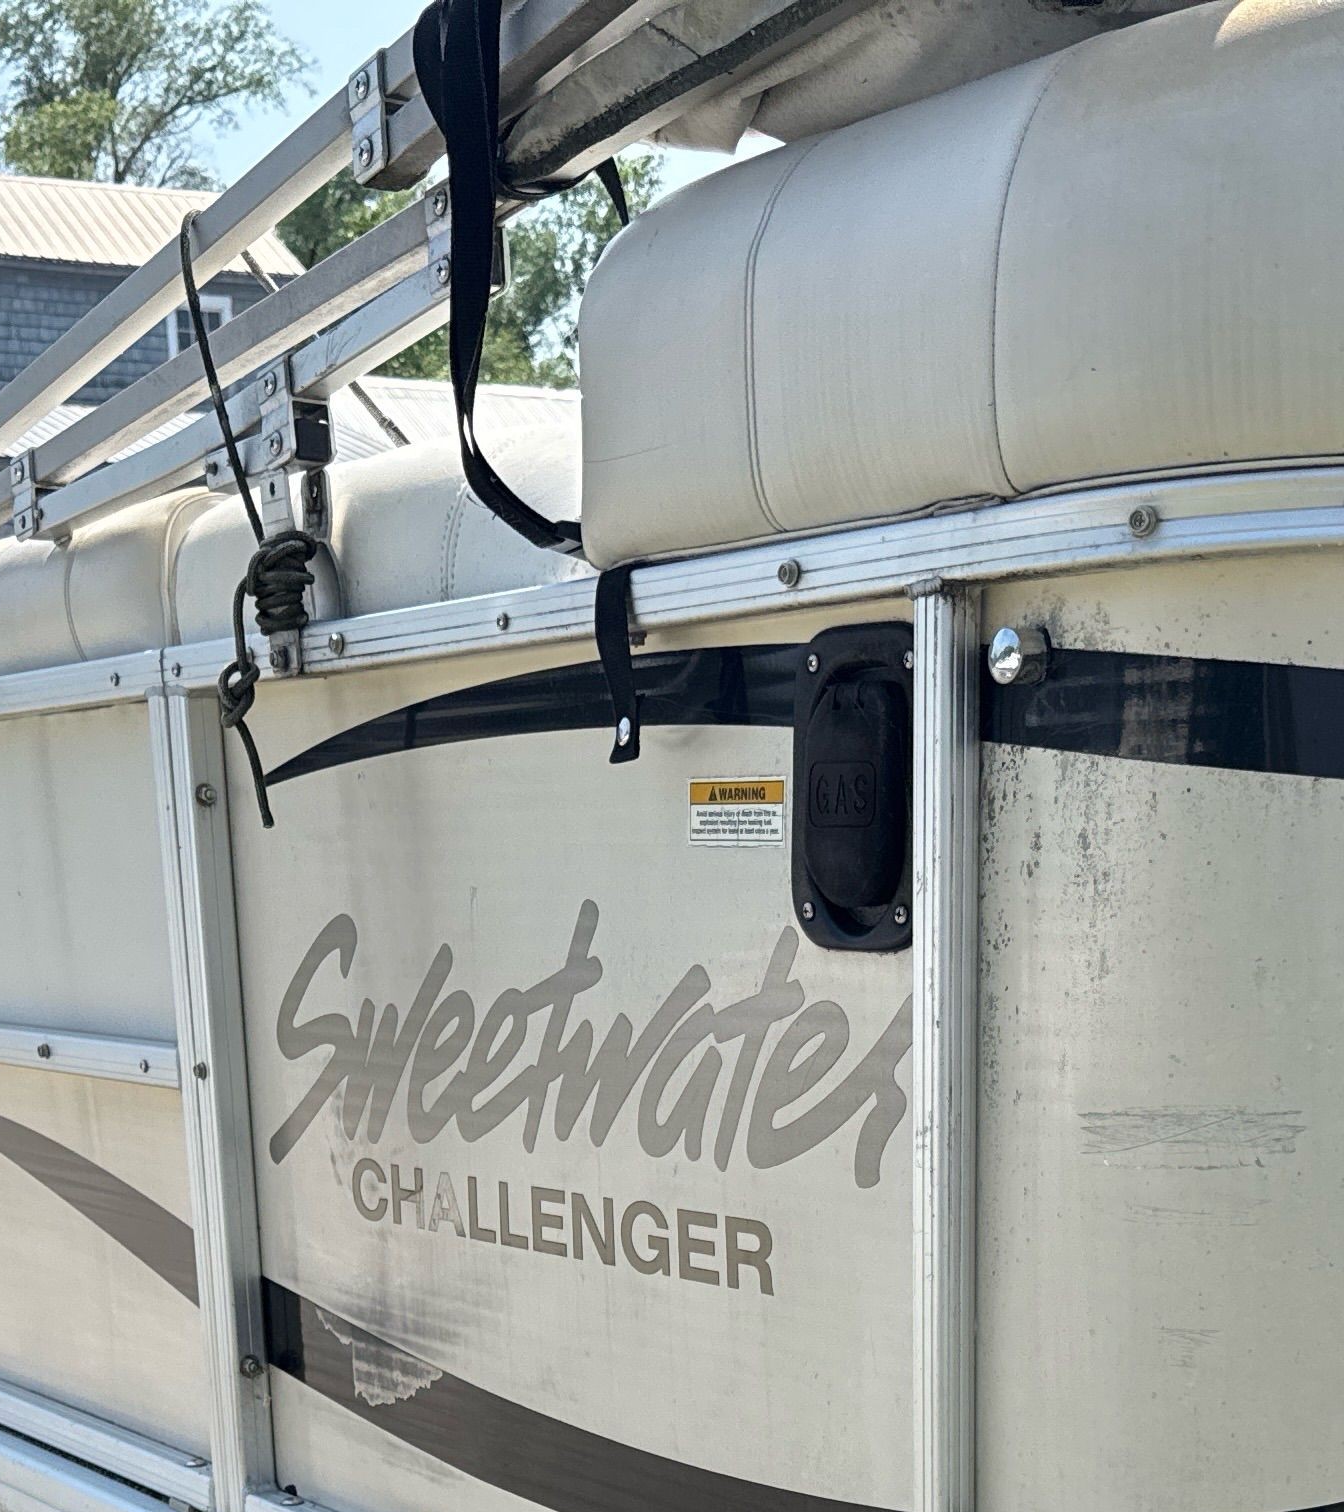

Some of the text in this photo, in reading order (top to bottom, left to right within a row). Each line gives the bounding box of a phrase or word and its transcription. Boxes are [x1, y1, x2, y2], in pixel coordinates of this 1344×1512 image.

[719, 786, 766, 801] WARNING
[816, 774, 868, 815] GAS
[270, 899, 913, 1188] Sweetwater
[351, 1157, 775, 1296] CHALLENGER
